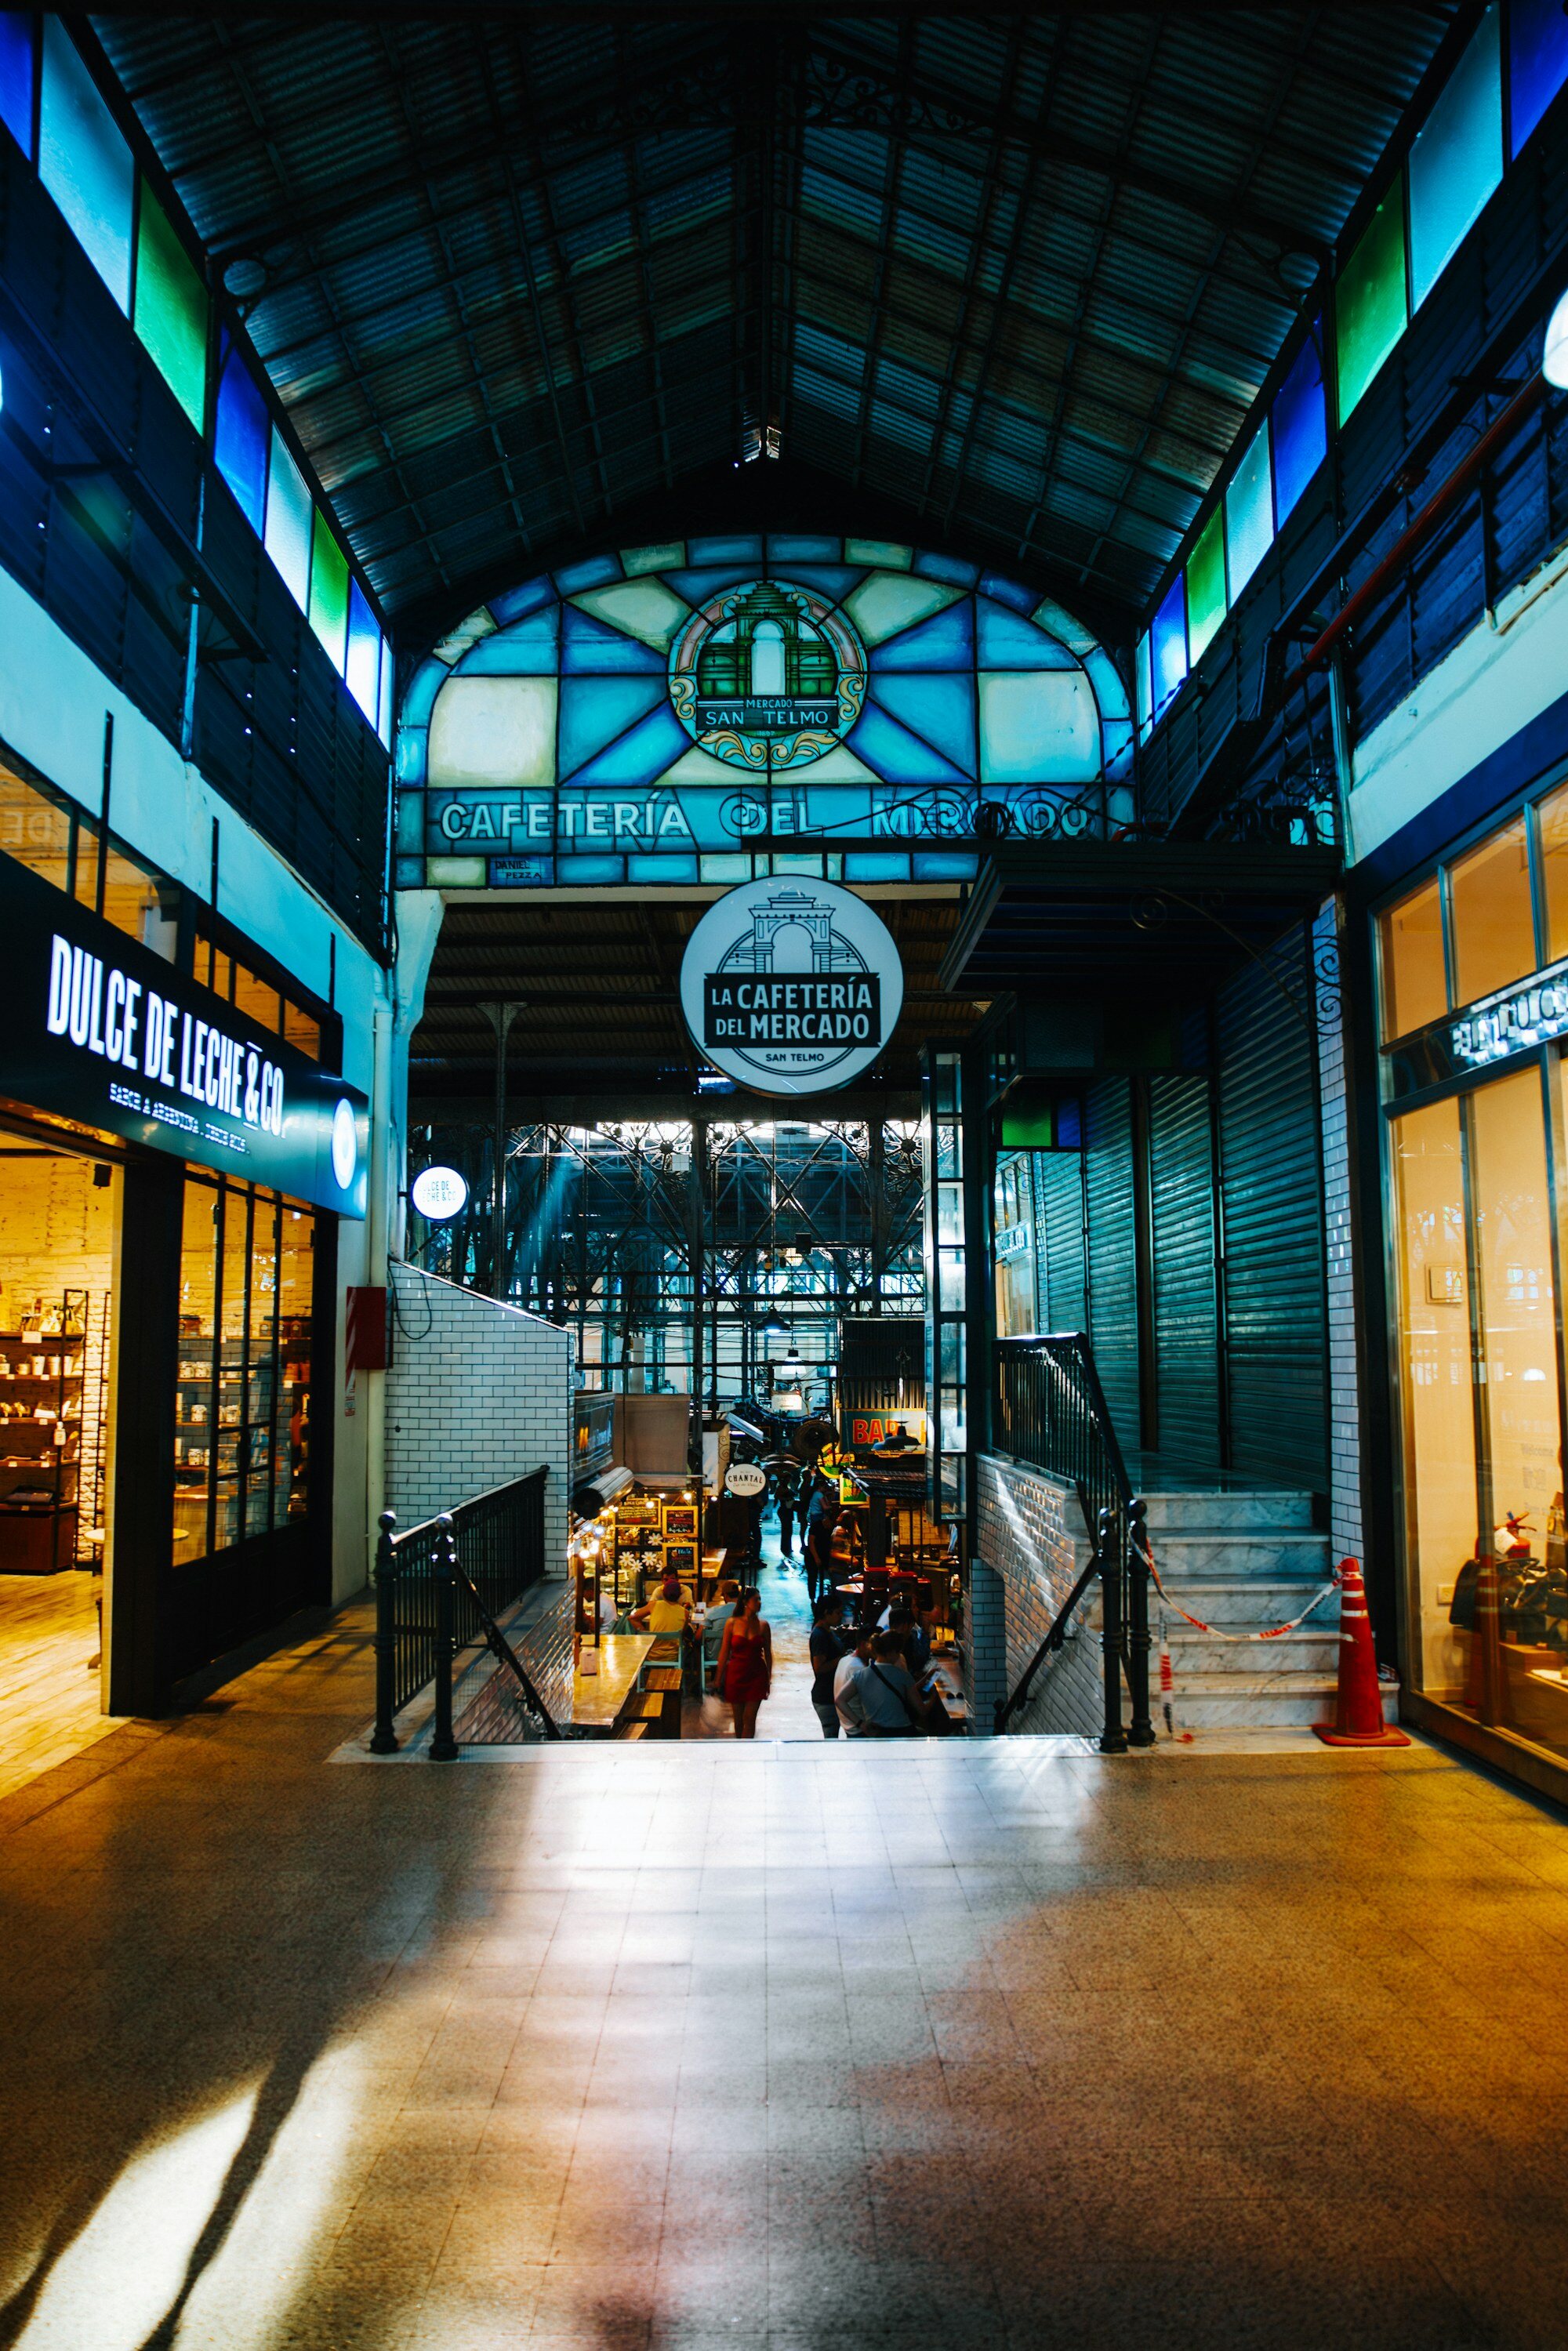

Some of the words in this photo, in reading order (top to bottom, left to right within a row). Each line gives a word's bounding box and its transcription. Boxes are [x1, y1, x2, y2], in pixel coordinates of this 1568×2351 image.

[746, 698, 793, 708] MERCADO
[706, 711, 744, 725] SAN
[763, 710, 829, 725] TELMO
[441, 789, 691, 840] CAFETERÍA
[740, 800, 823, 837] DEL
[495, 860, 531, 869] DANIEL
[712, 988, 732, 1006] LA
[737, 977, 873, 1010] CAFETERÍA
[47, 933, 141, 1071] DULCE
[144, 990, 179, 1088] DE
[180, 1012, 246, 1120] LECHE
[244, 1051, 261, 1123] &
[716, 1018, 746, 1036] DEL
[750, 1014, 869, 1039] MERCADO
[765, 1053, 786, 1062] SAN
[790, 1053, 825, 1062] TELMO
[441, 1180, 450, 1191] DE
[441, 1192, 447, 1202] &
[852, 1418, 901, 1445] BAR
[728, 1475, 764, 1484] CHANTAL
